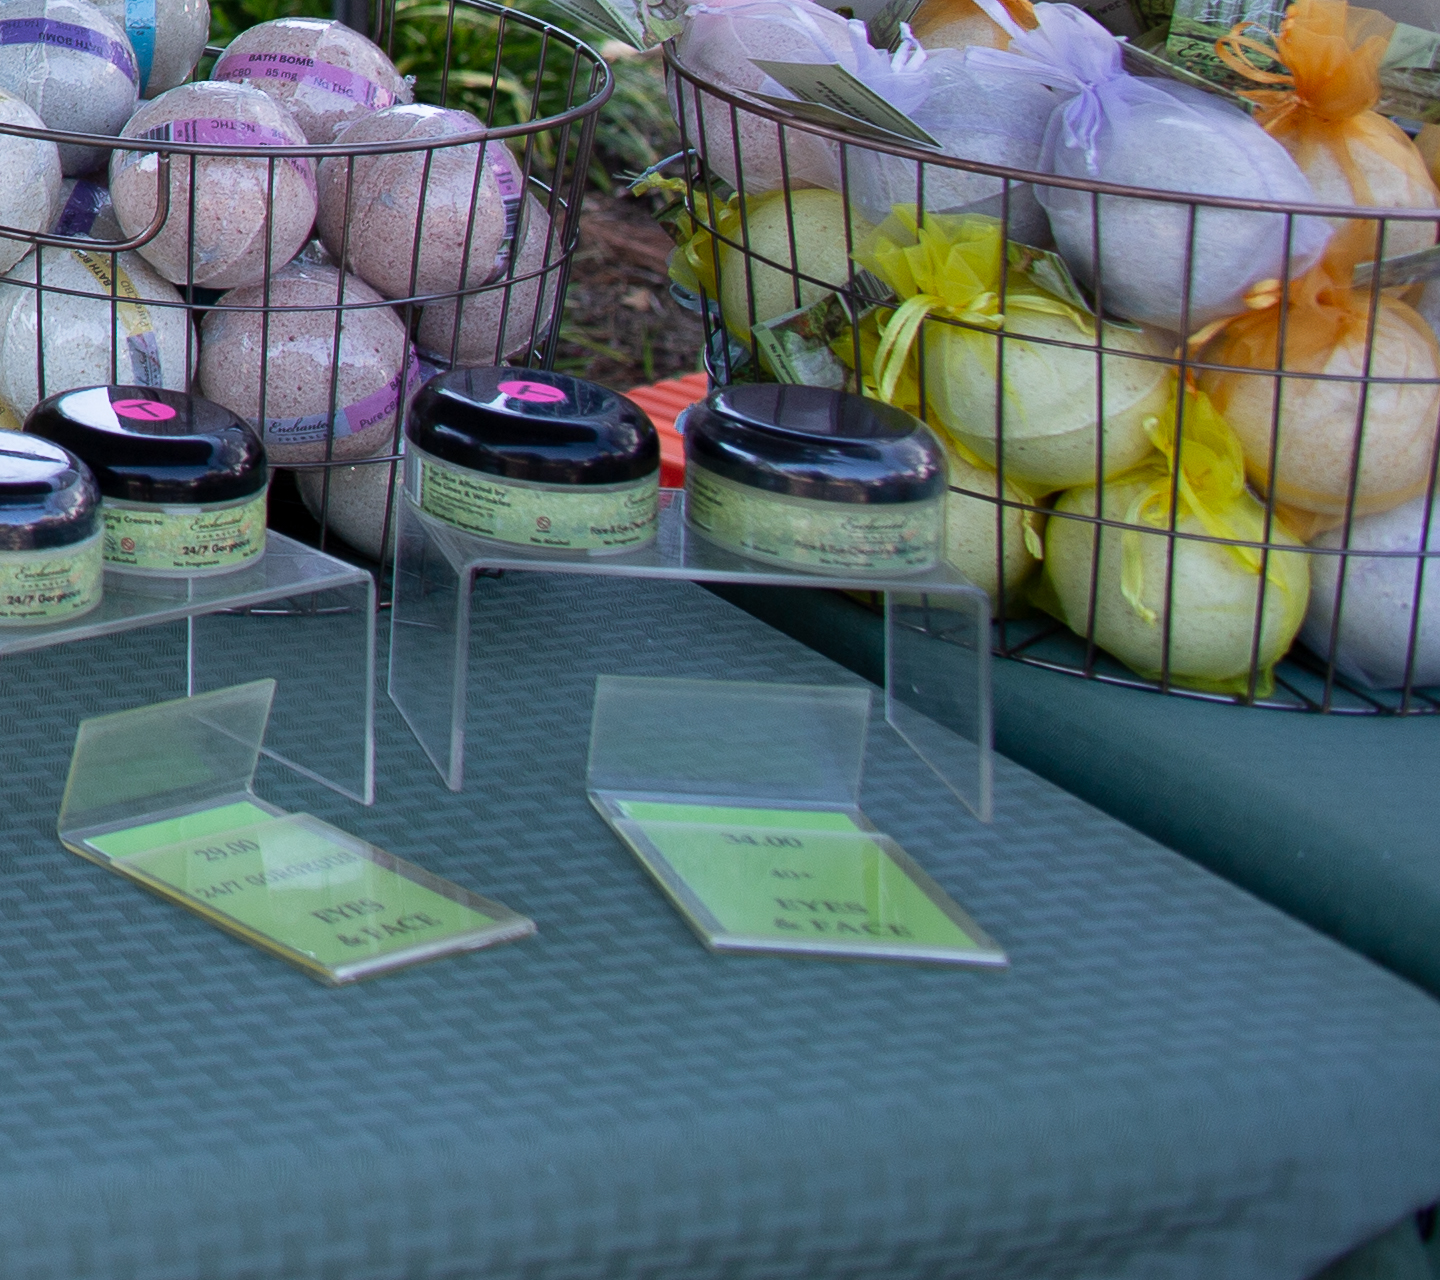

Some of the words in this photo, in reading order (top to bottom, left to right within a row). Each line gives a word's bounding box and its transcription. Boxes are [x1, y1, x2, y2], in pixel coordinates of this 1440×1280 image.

[249, 54, 277, 62] BATH
[279, 55, 314, 67] BOMB
[232, 68, 251, 77] CBD
[280, 71, 298, 81] mg
[331, 83, 354, 97] THC
[359, 412, 383, 428] Pure
[182, 545, 208, 555] 24/7
[194, 839, 261, 863] 29.00
[194, 879, 244, 900] 24/7
[312, 898, 386, 926] EYES
[774, 898, 869, 916] EYES
[365, 908, 444, 946] FACE
[808, 919, 916, 938] FACE
